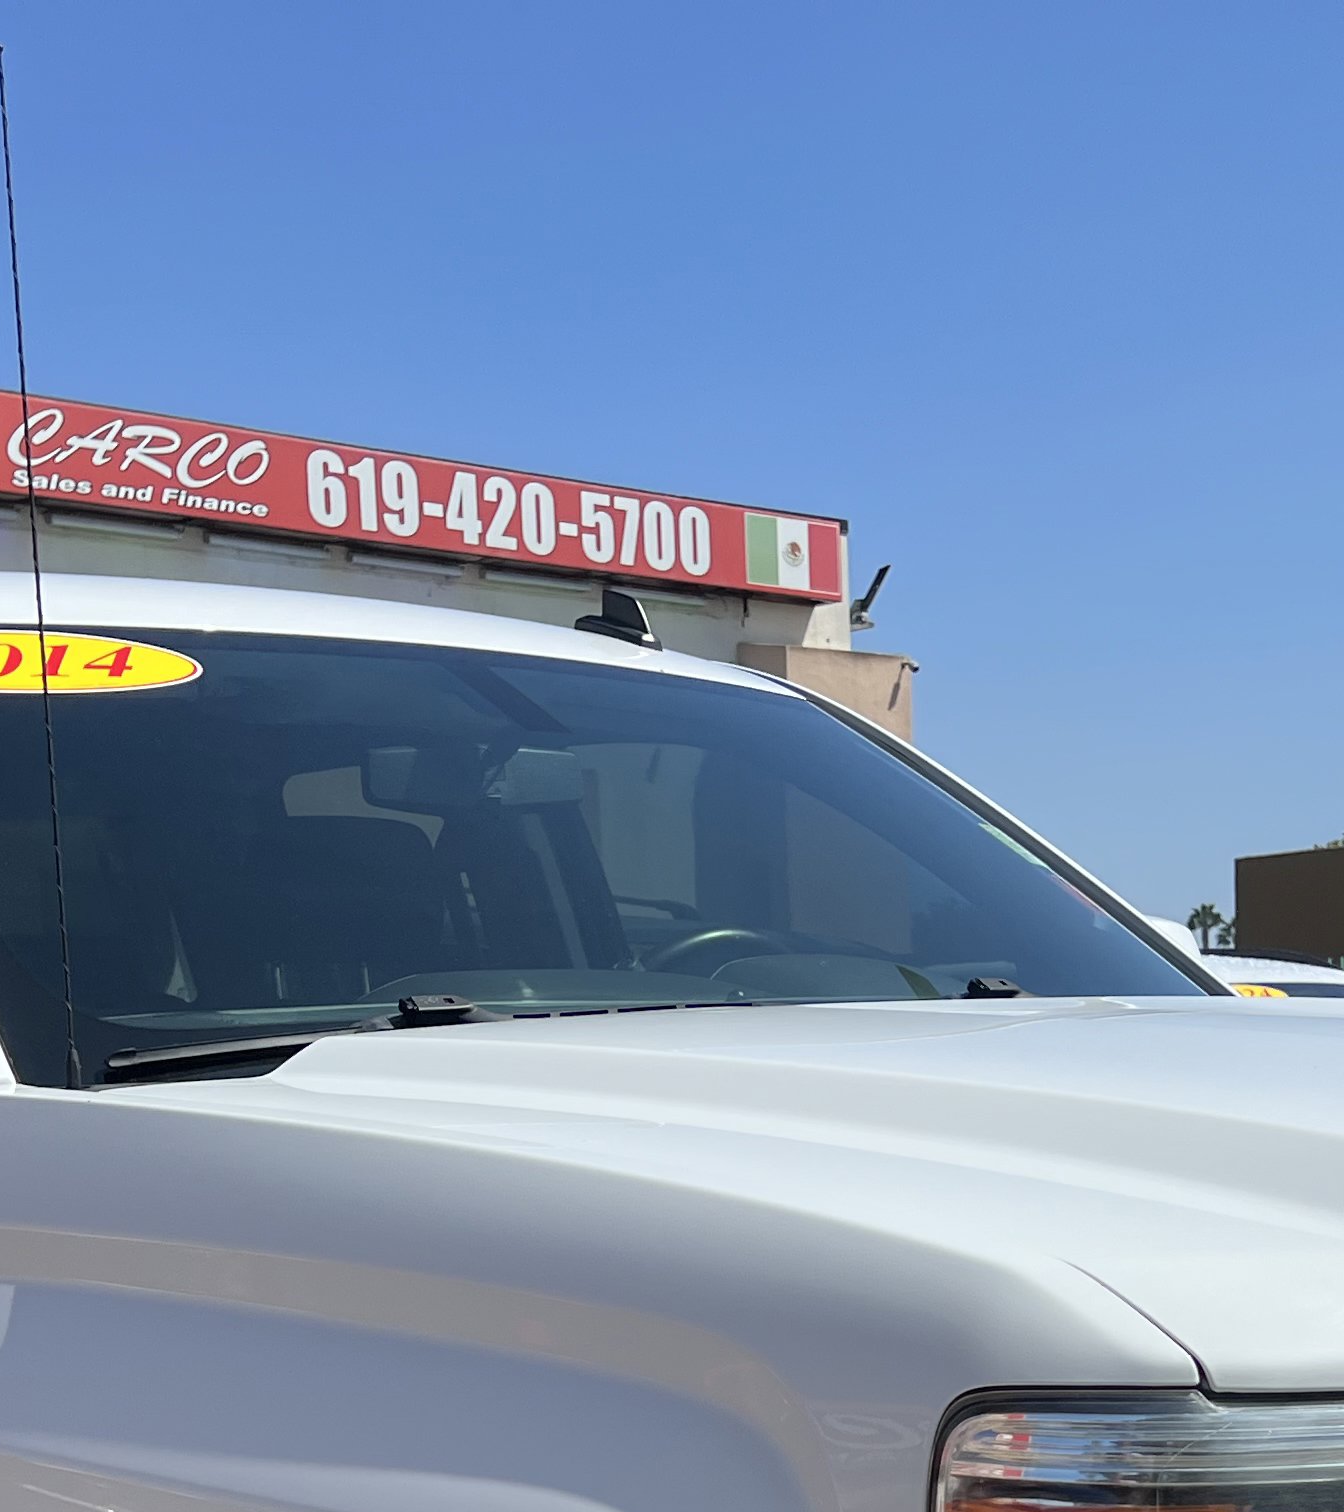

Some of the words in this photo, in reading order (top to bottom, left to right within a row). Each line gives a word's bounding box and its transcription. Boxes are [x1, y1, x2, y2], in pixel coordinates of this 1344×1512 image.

[7, 408, 270, 488] CARCO
[11, 468, 93, 495] Sales
[101, 481, 154, 503] and
[161, 487, 269, 518] Finance
[306, 448, 711, 577] 619-420-5700
